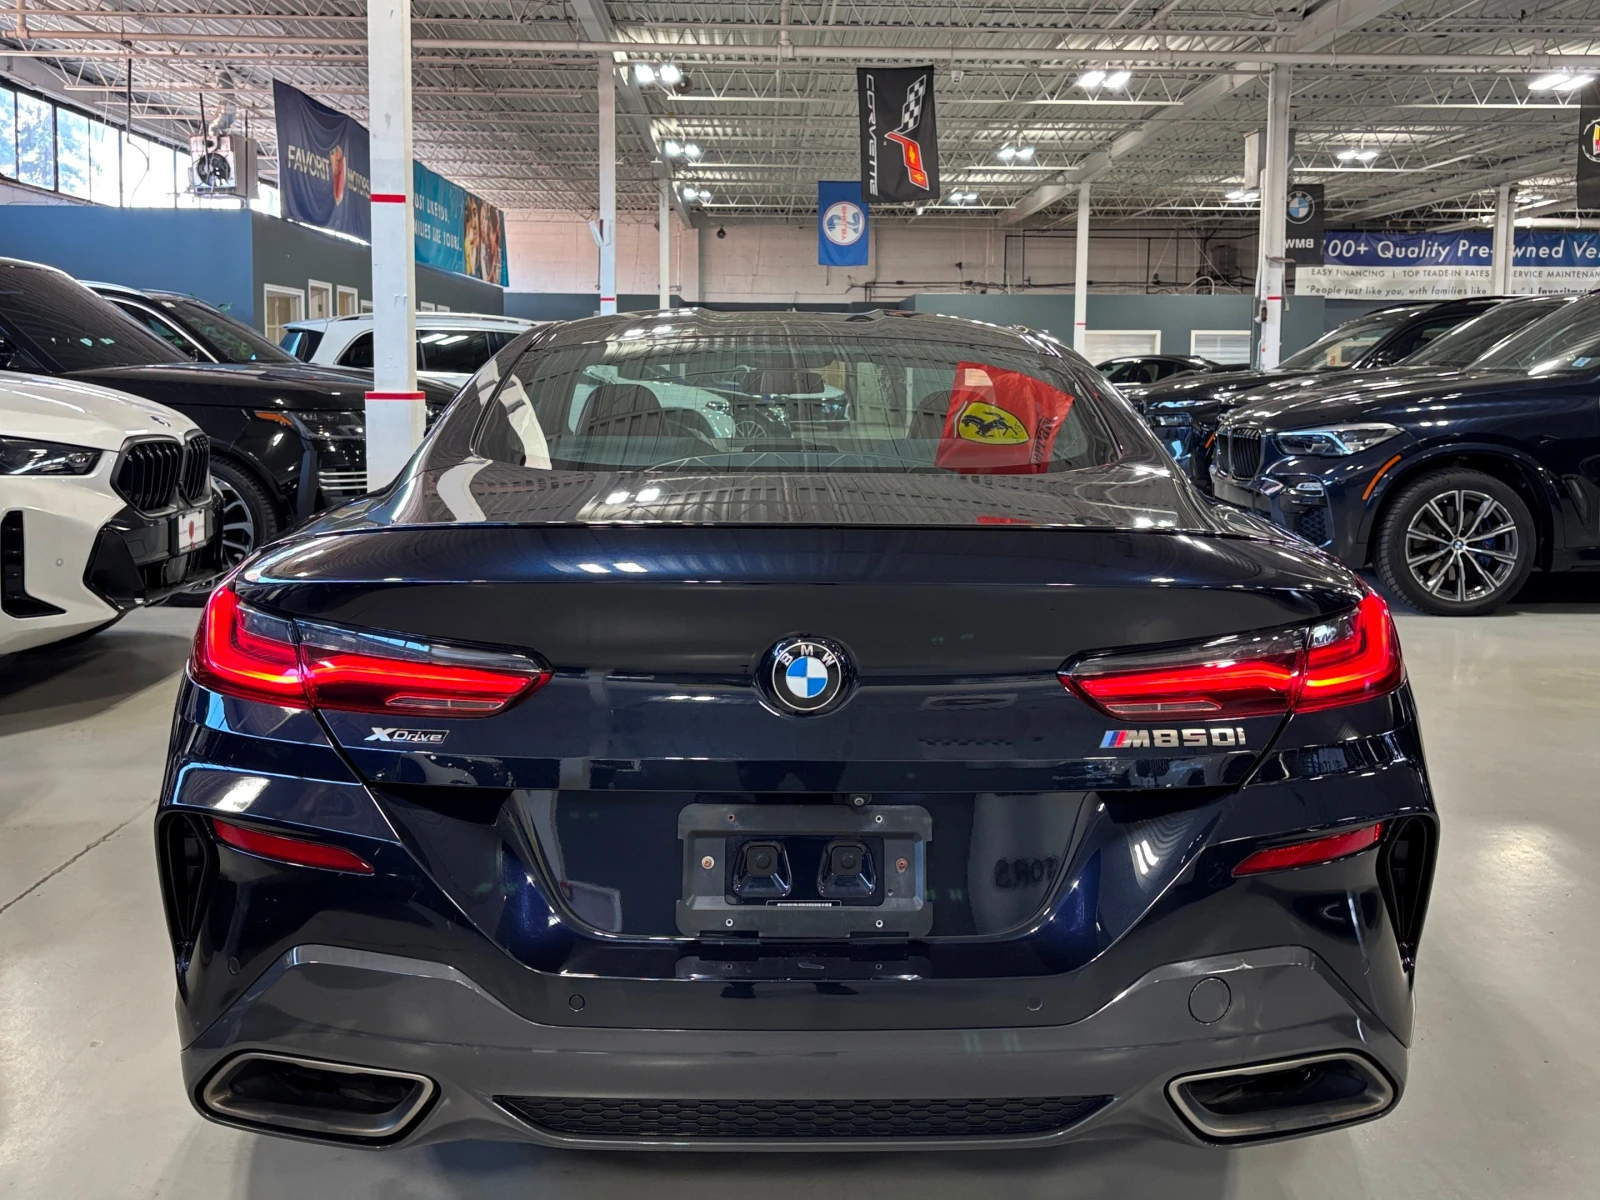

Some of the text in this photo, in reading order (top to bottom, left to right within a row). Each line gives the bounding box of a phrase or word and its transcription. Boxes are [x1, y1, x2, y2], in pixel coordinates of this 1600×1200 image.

[866, 74, 878, 196] CORVETTE
[288, 144, 330, 181] FAVORIT
[414, 192, 424, 211] UST
[1377, 239, 1450, 263] Quality
[1457, 239, 1565, 259] Pre-wned
[1311, 268, 1333, 277] EASY
[1336, 269, 1385, 278] FINANCING
[1403, 270, 1420, 278] TOP
[1465, 270, 1490, 278] RATES
[1513, 270, 1543, 278] ERVICE
[1344, 287, 1363, 296] just
[1365, 286, 1382, 296] like
[1385, 287, 1405, 297] you,
[1408, 286, 1428, 295] with
[1431, 286, 1468, 295] families
[1470, 286, 1487, 295] like
[779, 644, 836, 667] BMW
[1122, 727, 1247, 748] M850i
